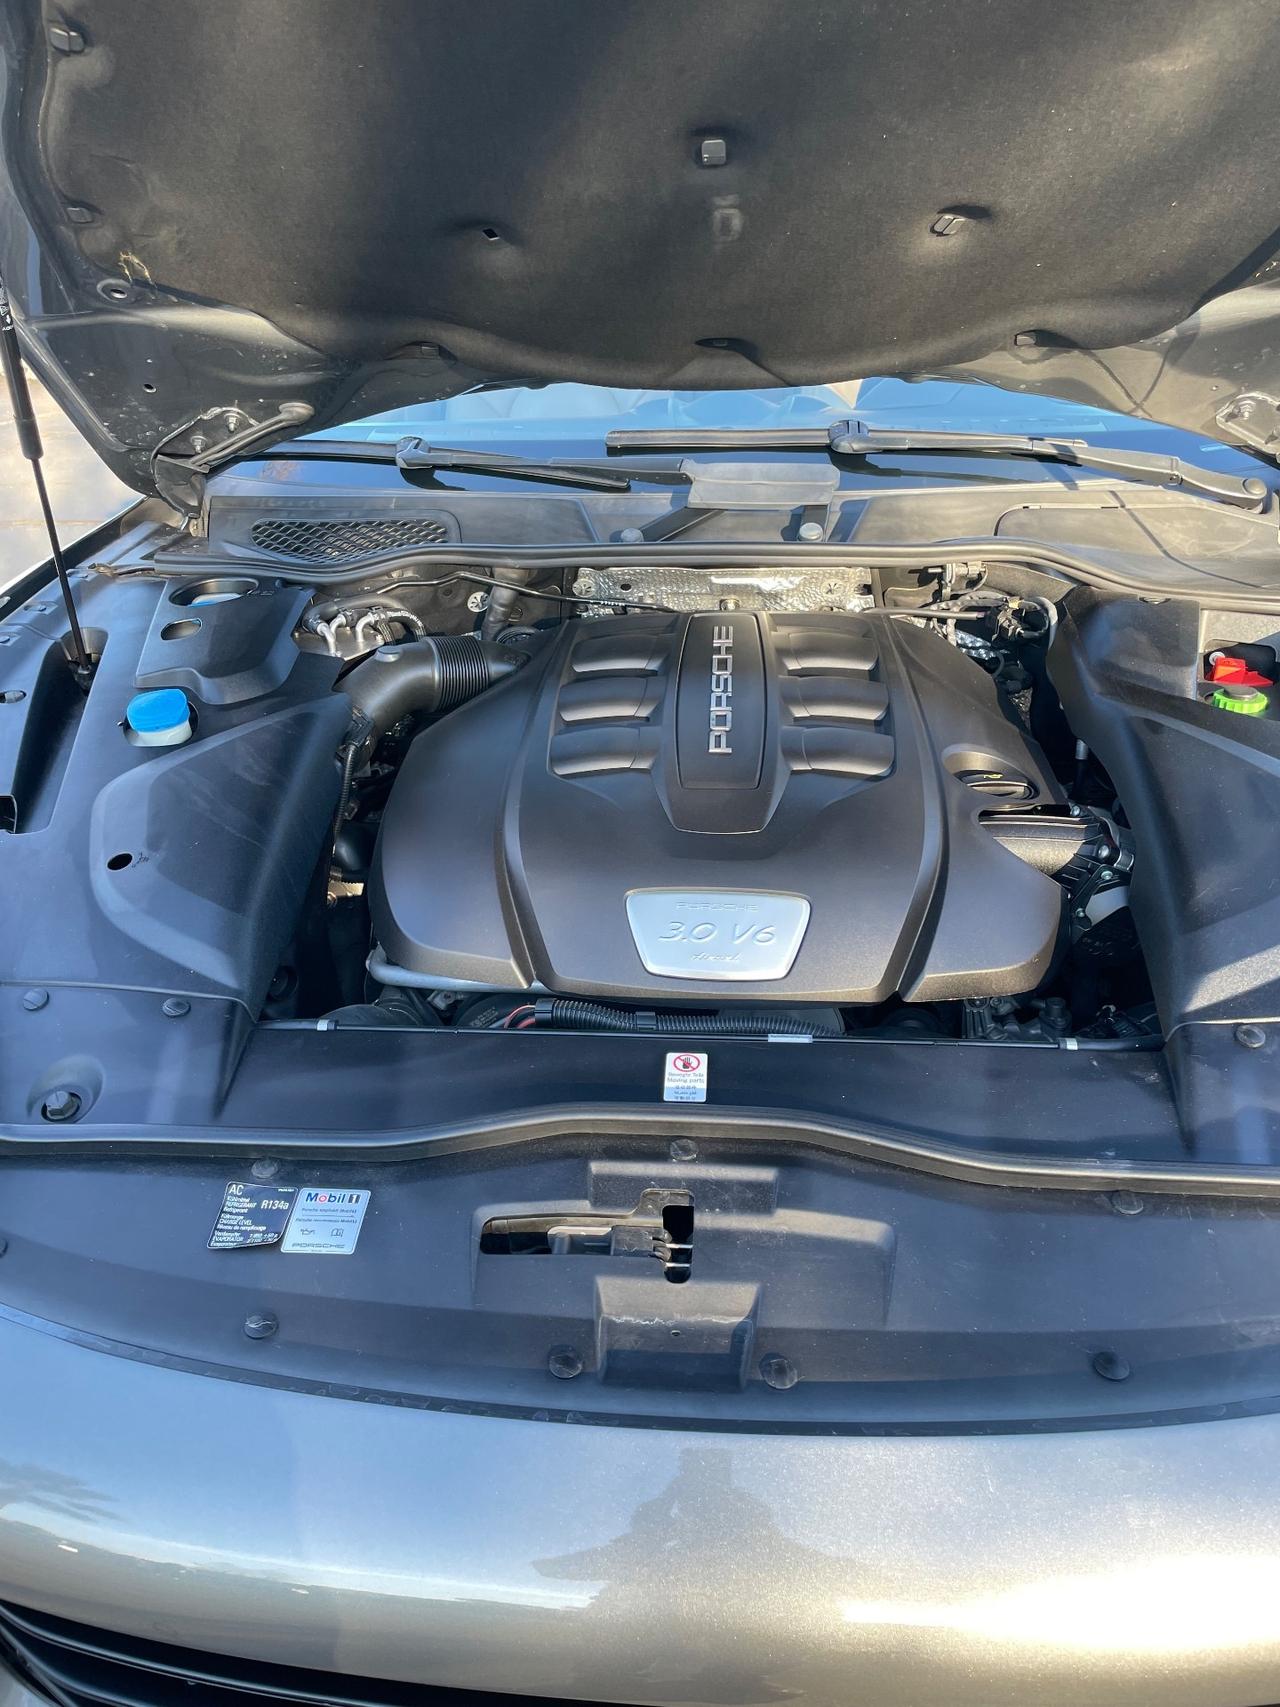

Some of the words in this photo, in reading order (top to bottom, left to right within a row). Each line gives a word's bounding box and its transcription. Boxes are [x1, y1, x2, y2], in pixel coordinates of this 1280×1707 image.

[708, 625, 734, 754] PORSCHE
[675, 902, 760, 912] PORSCHE
[658, 921, 719, 943] 3.0
[733, 923, 777, 945] V6
[229, 1184, 244, 1195] AC
[305, 1192, 346, 1204] Mobil
[261, 1200, 289, 1210] R134a
